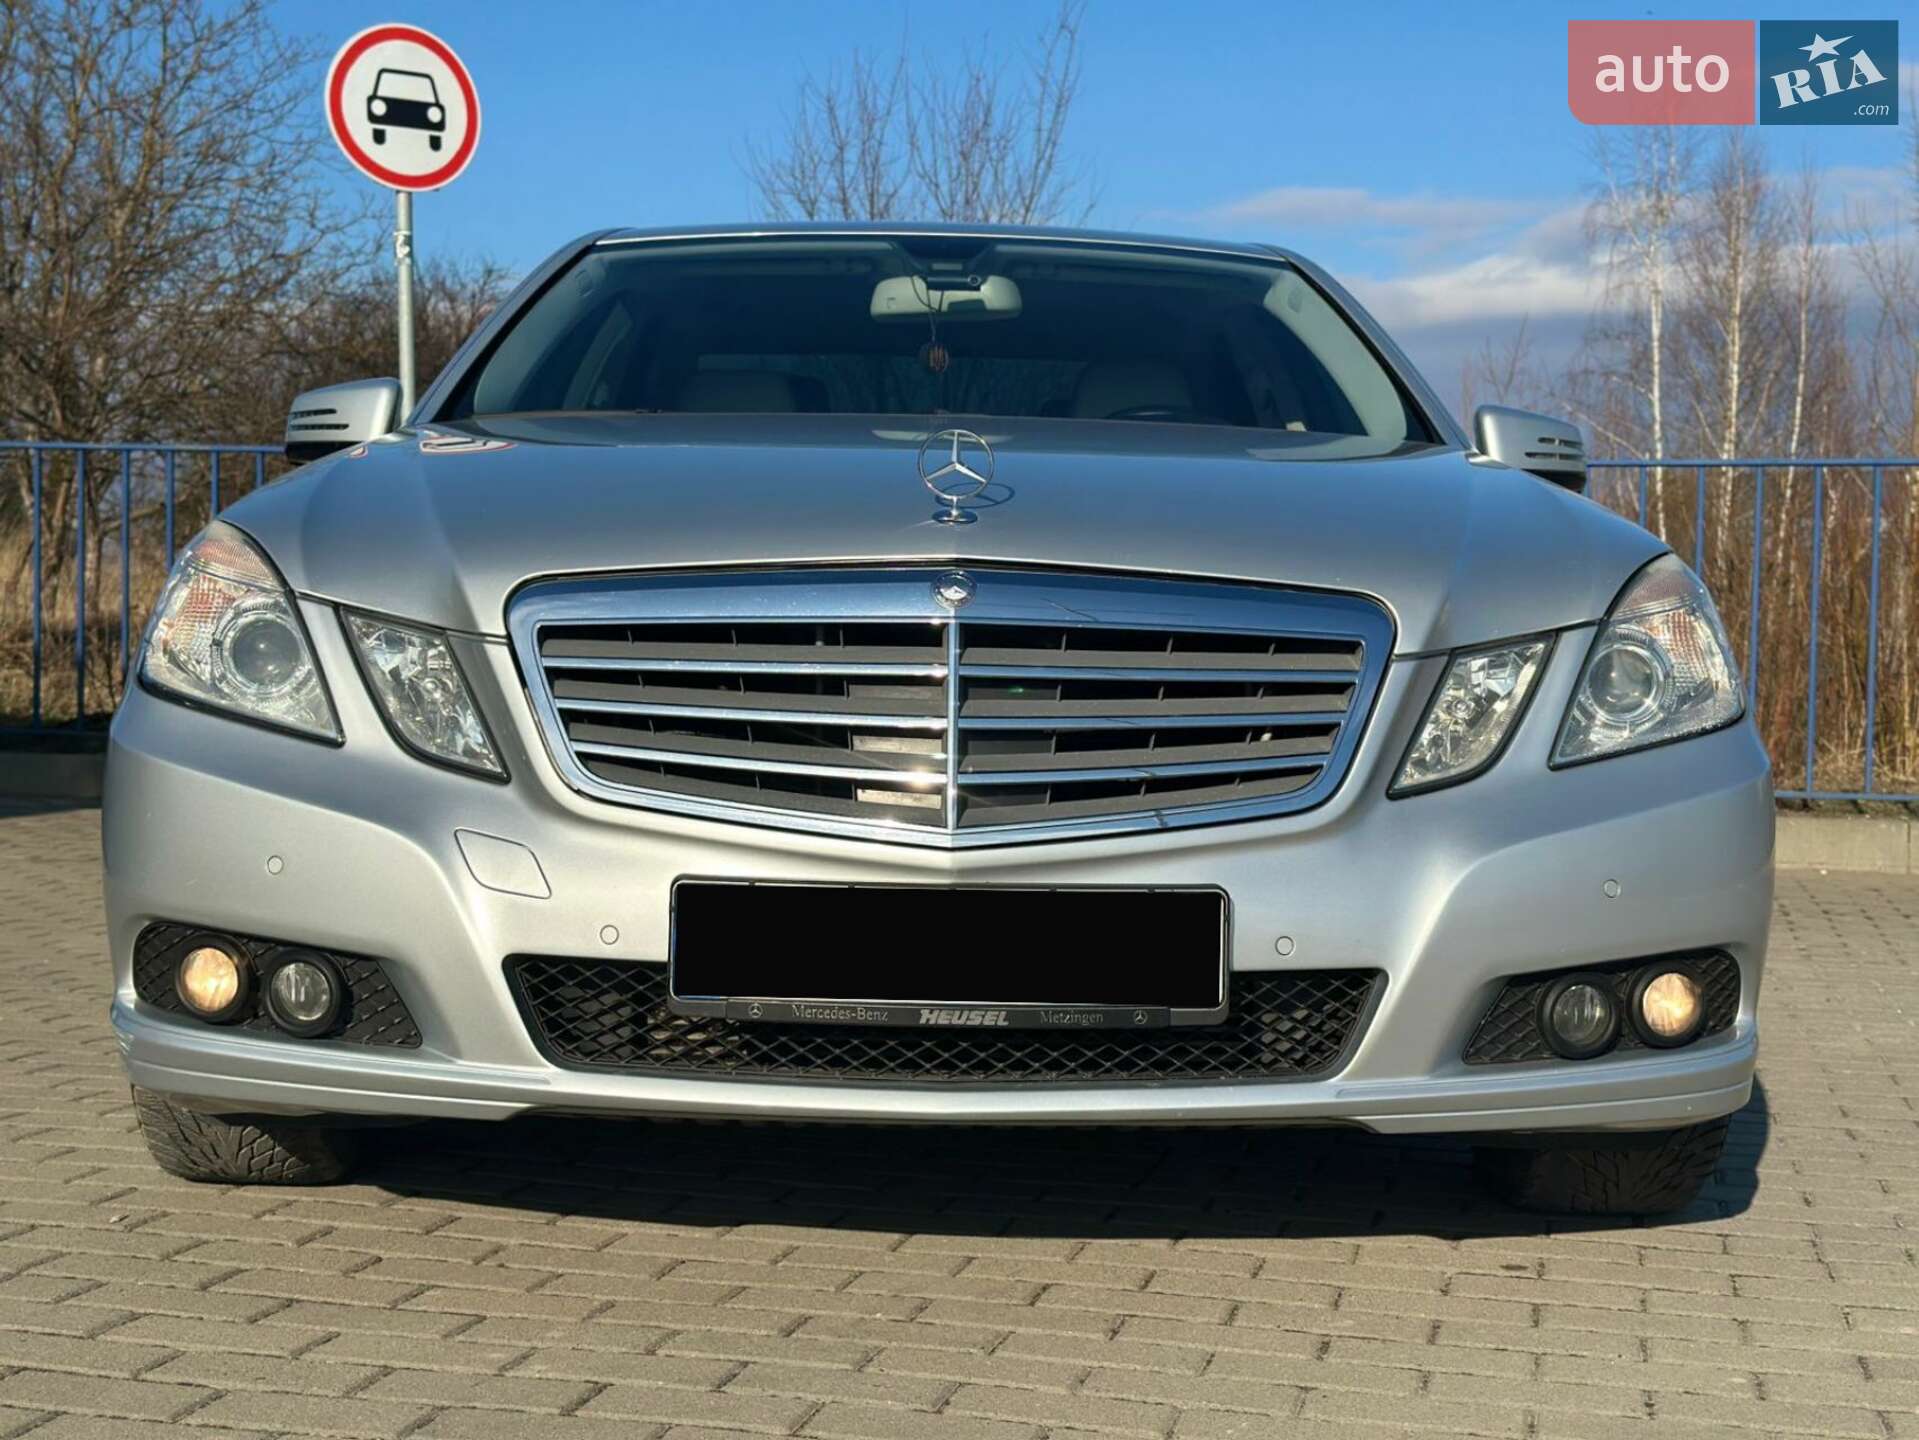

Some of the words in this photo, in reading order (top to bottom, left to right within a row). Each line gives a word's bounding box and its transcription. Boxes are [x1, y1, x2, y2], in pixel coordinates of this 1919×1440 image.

[792, 1004, 888, 1022] Mercedes-Benz
[919, 1008, 1009, 1025] HEUSEL
[1040, 1010, 1104, 1026] Metzingen
